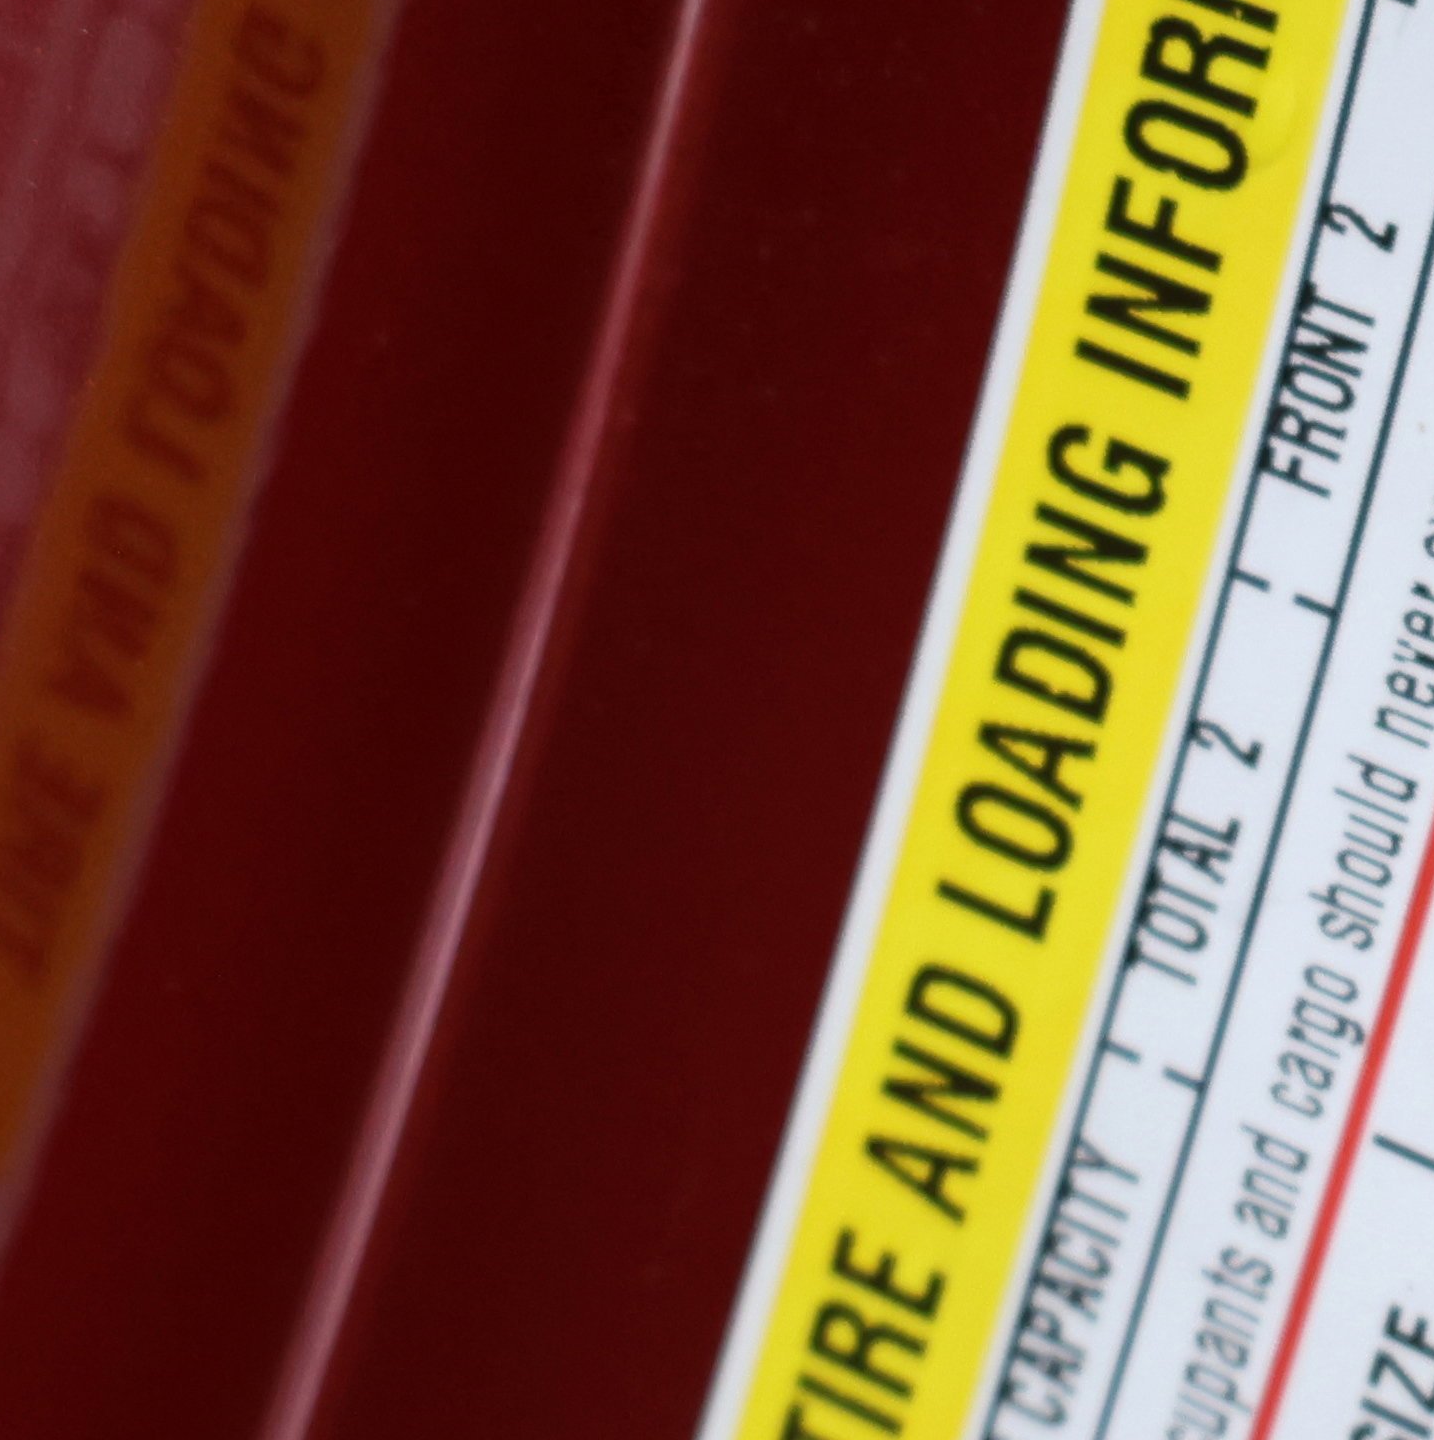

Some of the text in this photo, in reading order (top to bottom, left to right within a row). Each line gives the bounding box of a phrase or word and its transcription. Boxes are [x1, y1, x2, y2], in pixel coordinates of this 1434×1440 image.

[1260, 203, 1399, 499] FRONT 2
[936, 424, 1172, 943] LOADING
[1128, 720, 1264, 987] TOTAL 2
[1311, 755, 1420, 950] should
[865, 962, 1021, 1226] AND
[1269, 962, 1366, 1120] cargo
[1001, 1130, 1140, 1428] CAPACITY
[1238, 1120, 1311, 1242] and
